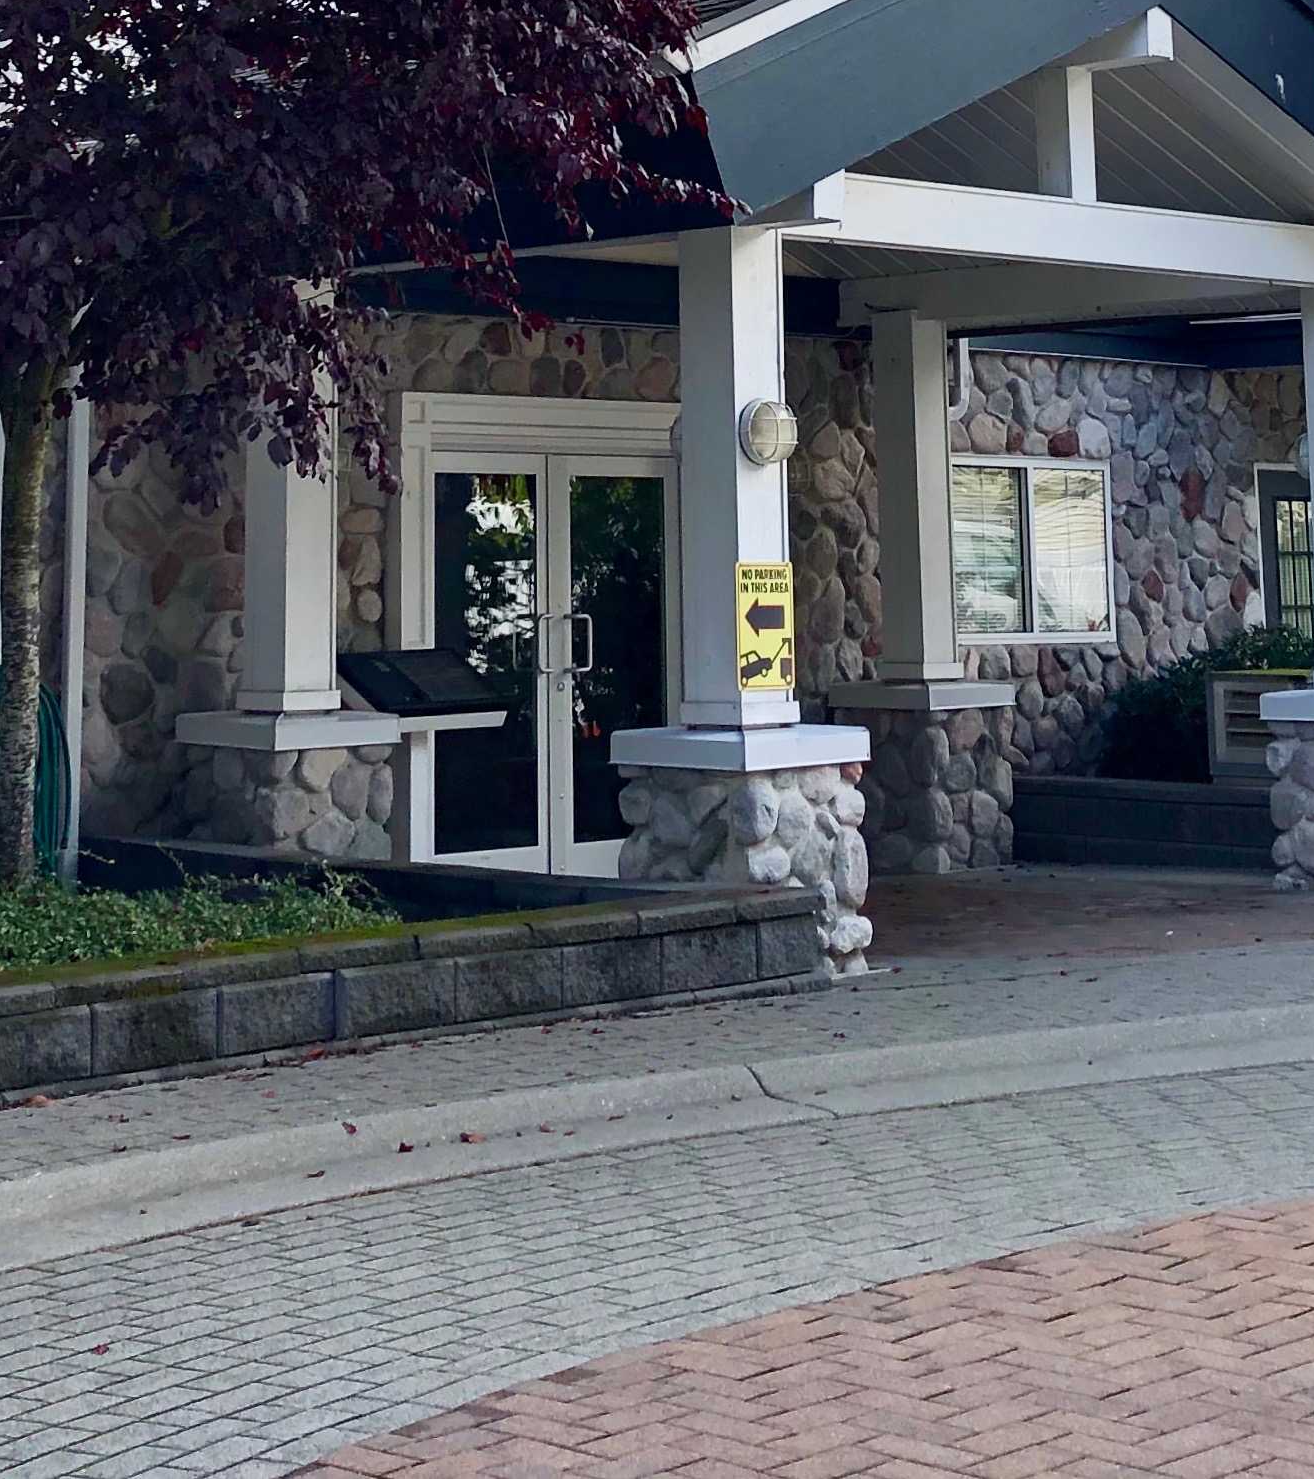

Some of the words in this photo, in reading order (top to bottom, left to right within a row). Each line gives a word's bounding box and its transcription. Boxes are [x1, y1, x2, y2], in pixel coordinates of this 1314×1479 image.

[741, 569, 753, 580] NO
[754, 569, 787, 580] PARKING
[740, 582, 749, 593] IN
[751, 582, 768, 593] THIS
[769, 582, 789, 593] AREA
